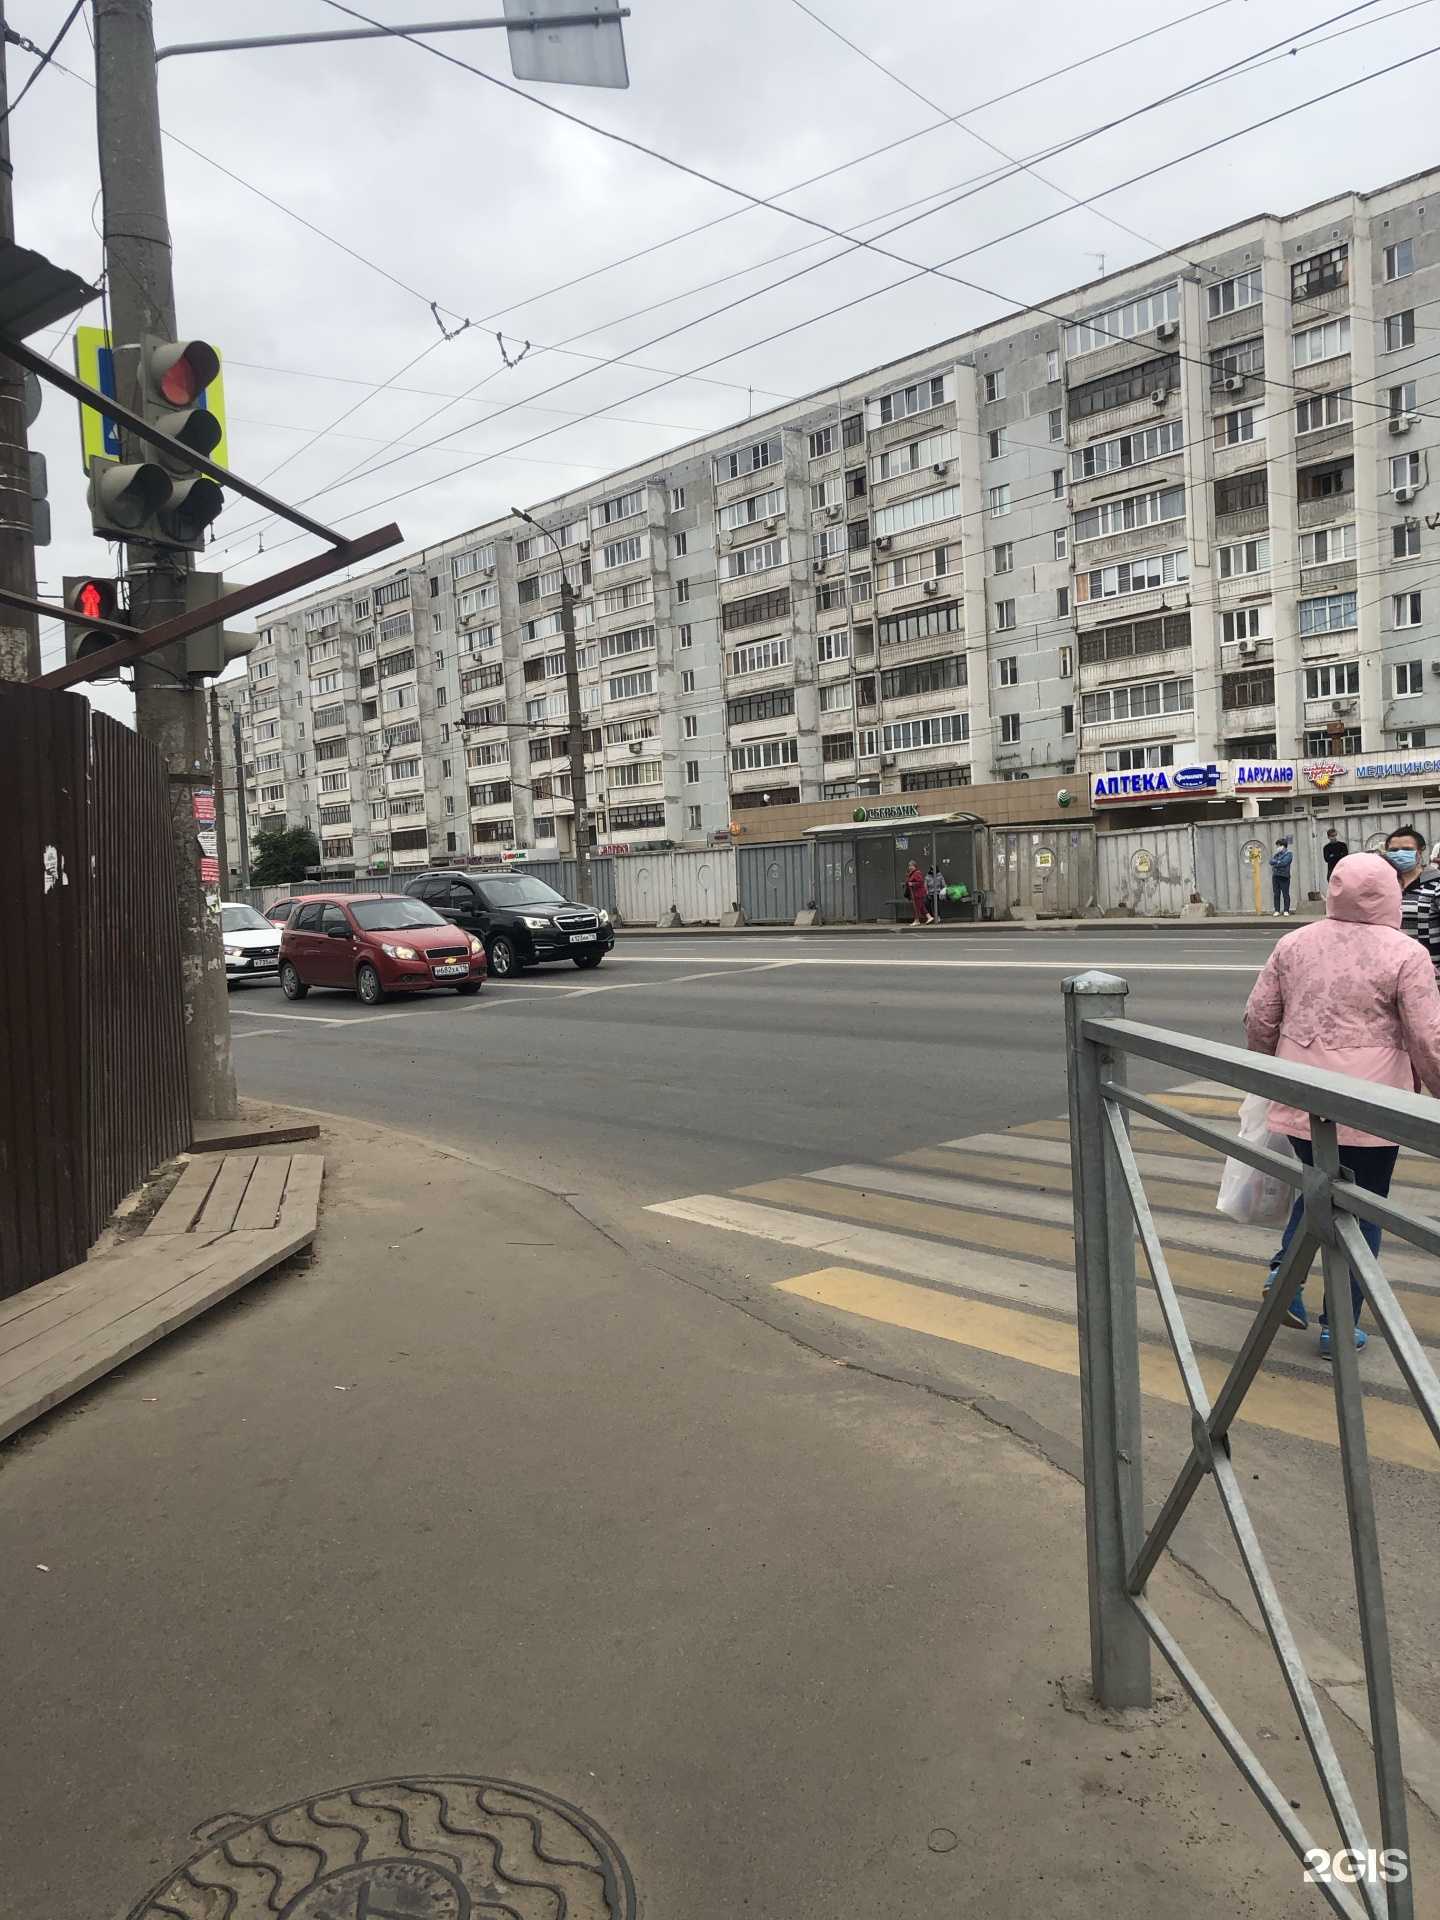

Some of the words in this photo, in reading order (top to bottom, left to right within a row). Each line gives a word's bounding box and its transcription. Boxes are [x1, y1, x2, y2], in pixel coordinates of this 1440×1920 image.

[1095, 772, 1169, 796] АПТЕКА
[1238, 766, 1294, 784] ДАРУХАНӘ
[867, 804, 919, 819] СБЕРБАНК
